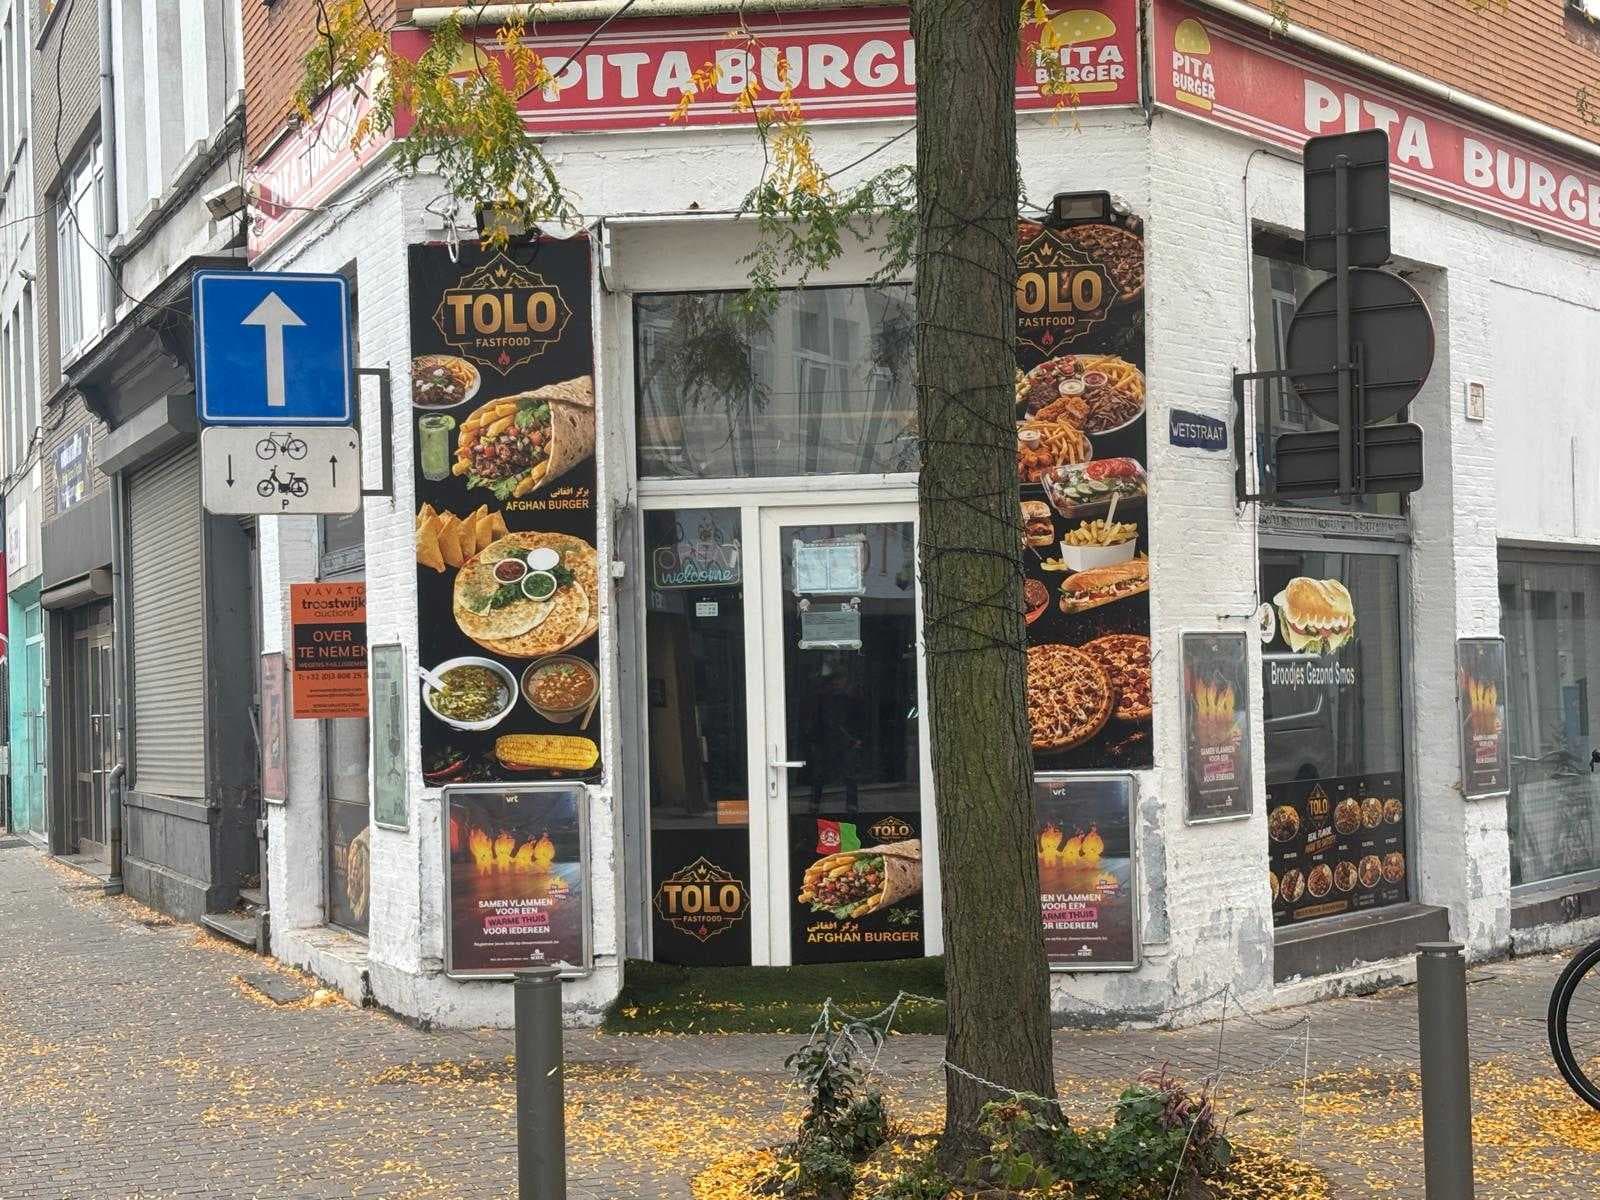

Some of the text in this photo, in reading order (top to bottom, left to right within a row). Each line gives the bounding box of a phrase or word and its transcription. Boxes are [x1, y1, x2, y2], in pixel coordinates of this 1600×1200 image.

[1172, 51, 1215, 82] PITA
[541, 51, 699, 103] PITA
[1035, 65, 1126, 84] BRGER
[1172, 70, 1217, 100] BURGER
[1304, 79, 1434, 170] PITA
[1016, 271, 1102, 313] OLO
[447, 292, 556, 335] TOLO
[1018, 316, 1075, 327] FASTFOOD
[475, 336, 531, 348] FASTFOOD
[1171, 422, 1224, 441] WETSTRAAT
[282, 499, 290, 510] P
[505, 499, 589, 512] AFGHAN BURGER
[662, 562, 732, 584] welcome
[313, 630, 353, 643] OVER
[298, 645, 368, 658] TE NEMEN
[1271, 661, 1305, 691] Broodjes
[1306, 661, 1334, 685] Gezond
[872, 825, 909, 836] TOLO
[478, 898, 553, 909] SAMEN VLAMMEN
[663, 884, 741, 914] TOLO
[1056, 893, 1102, 902] VLAMMEN
[496, 907, 520, 915] VOOR
[1068, 902, 1086, 910] EEN
[521, 914, 546, 923] THUIS
[1043, 912, 1066, 920] ARME
[482, 926, 551, 935] VOOR IEDEREEN
[1055, 922, 1099, 930] IEDEREEN
[807, 931, 920, 943] AFGHAN BURGER
